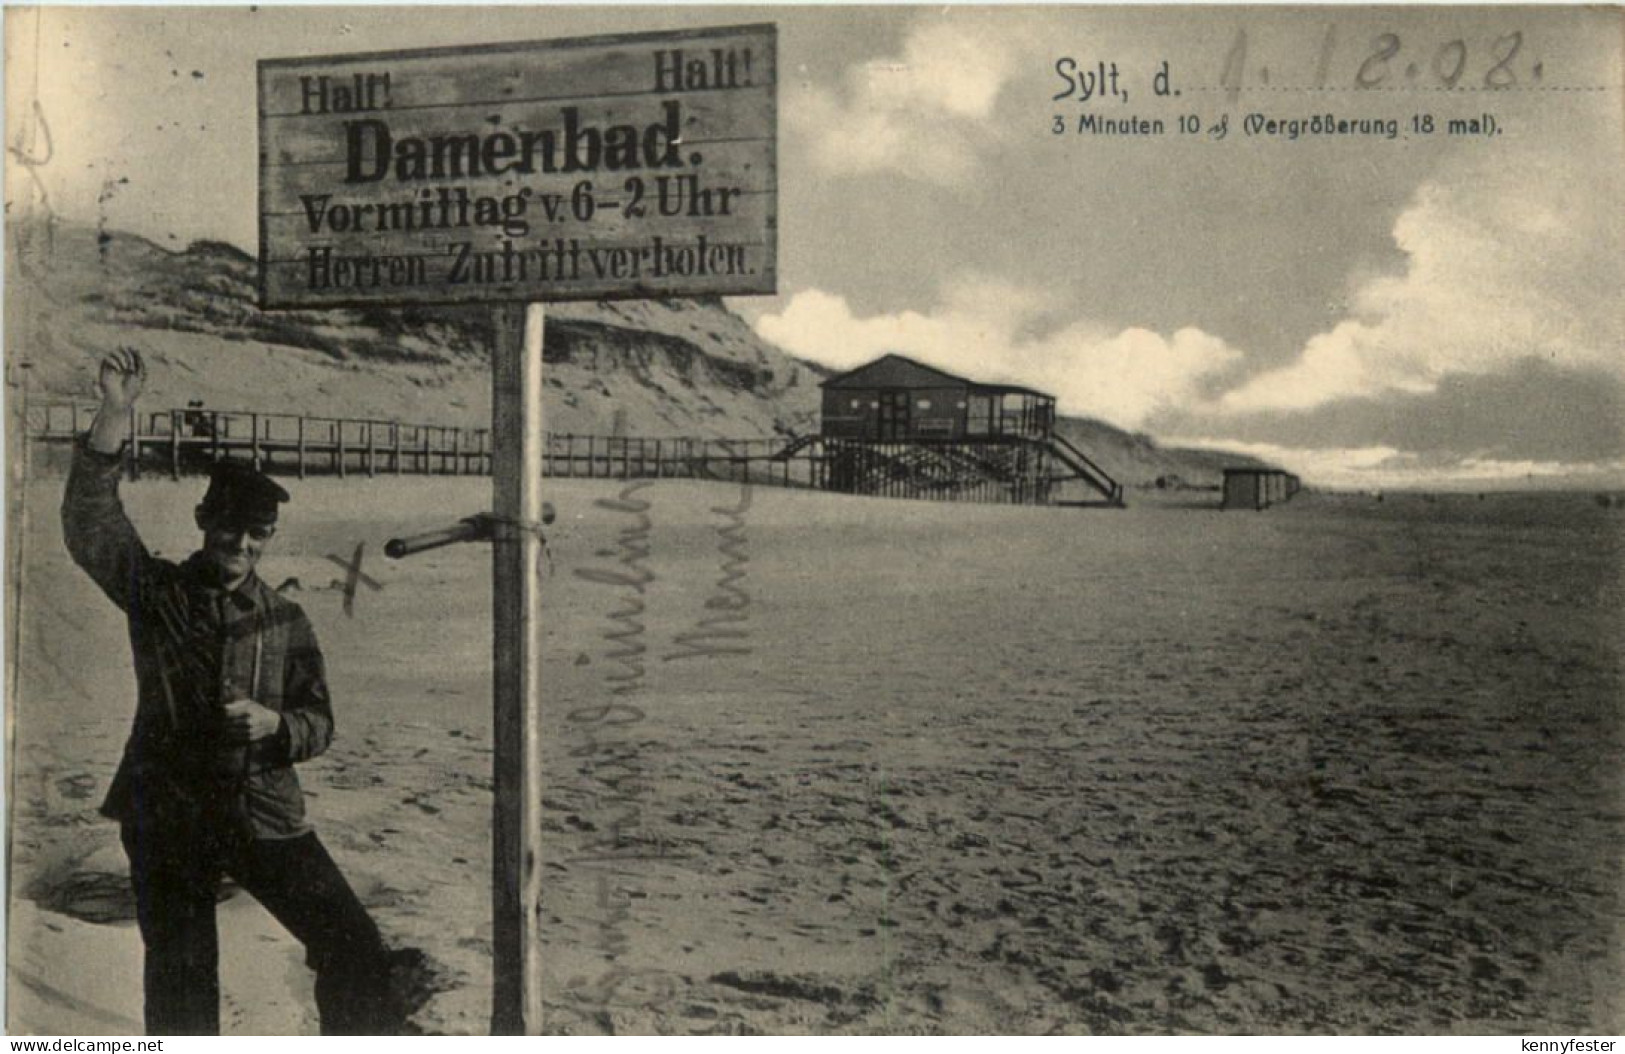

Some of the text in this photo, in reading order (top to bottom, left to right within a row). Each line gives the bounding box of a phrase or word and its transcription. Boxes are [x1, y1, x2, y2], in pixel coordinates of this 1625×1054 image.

[299, 48, 751, 114] Halt! Halt!
[1052, 57, 1181, 104] Sylt, d.
[343, 100, 703, 184] Damenbad.
[1051, 114, 1065, 135] 3
[1078, 114, 1164, 135] Minuten
[1178, 114, 1200, 135] 10
[1411, 113, 1435, 135] 18
[1447, 112, 1503, 137] mal).
[298, 186, 532, 238] Vormittag
[655, 174, 742, 218] Uhr
[307, 235, 755, 290] Herren Zutritt verboten.
